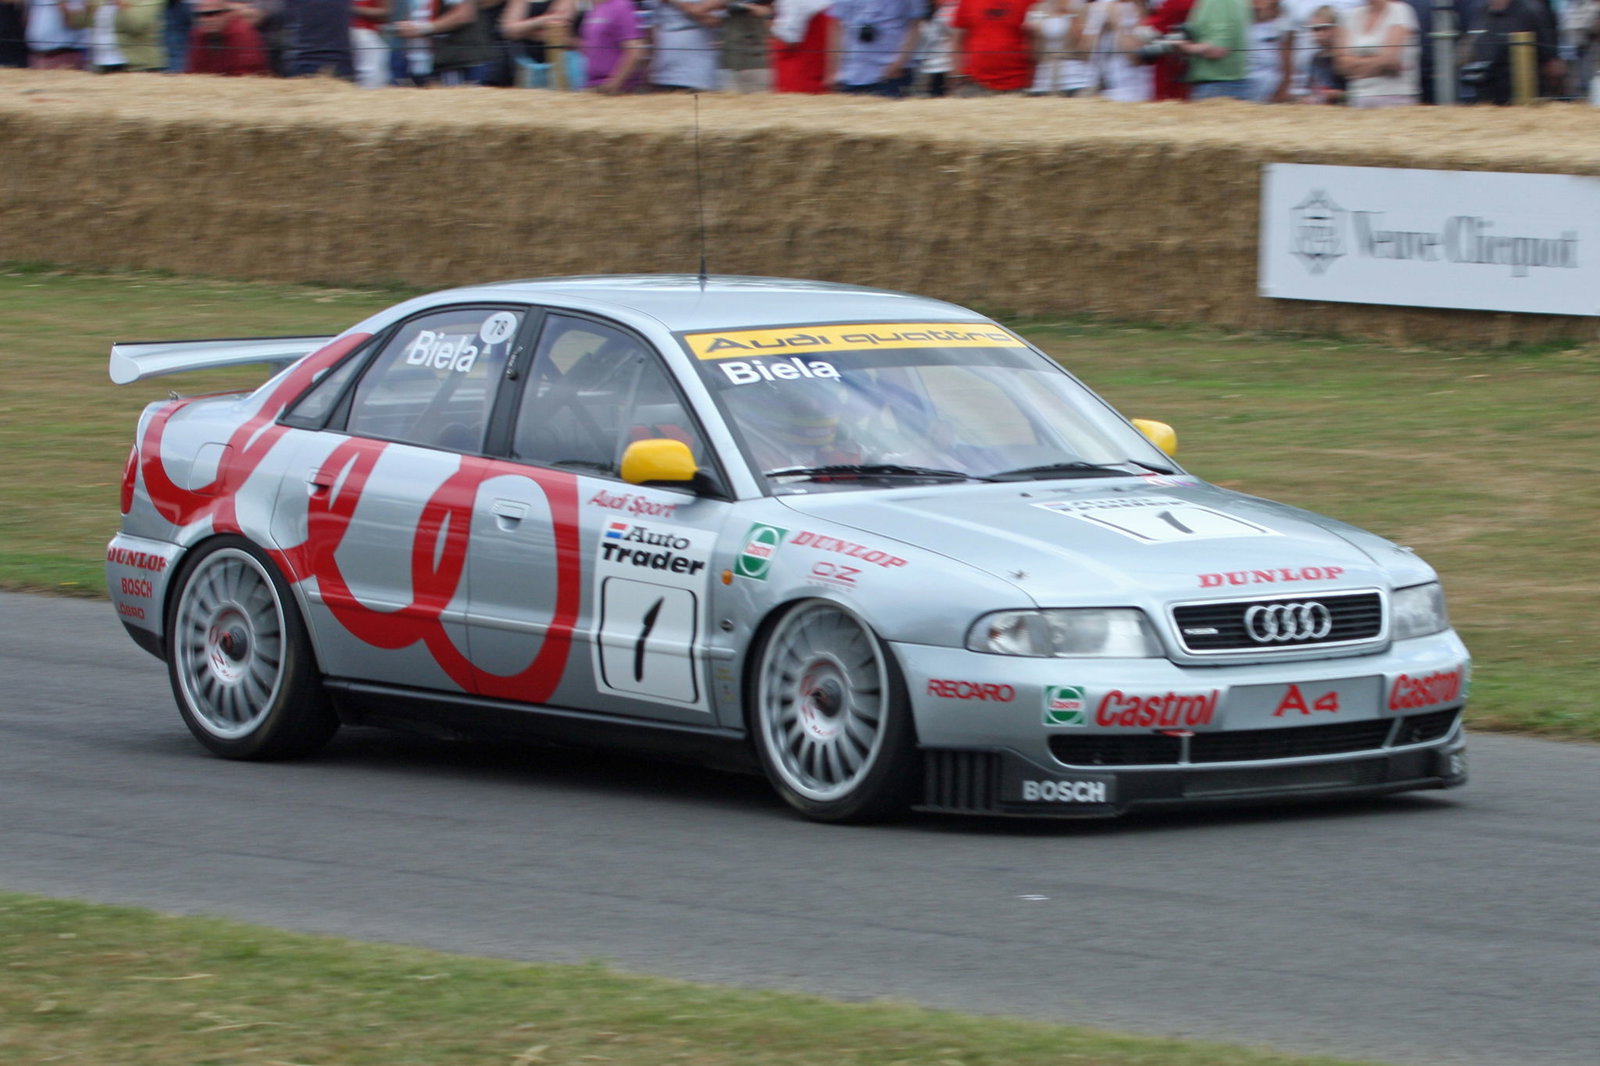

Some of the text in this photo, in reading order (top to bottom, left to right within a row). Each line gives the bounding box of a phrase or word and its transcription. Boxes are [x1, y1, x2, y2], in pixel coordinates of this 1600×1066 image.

[406, 330, 478, 372] Biela
[705, 329, 1015, 353] Audi quattro
[718, 357, 841, 386] Biela
[588, 490, 677, 518] Audi Sport
[622, 525, 690, 550] Auto
[789, 531, 909, 568] DUNLOP
[107, 548, 166, 572] DUNLOP
[601, 542, 705, 575] Trader
[121, 577, 152, 599] BOSCH
[1195, 565, 1345, 588] DUNLOP
[634, 596, 664, 682] 1
[927, 679, 1016, 702] RECARO
[1272, 683, 1339, 716] A4
[1095, 689, 1220, 728] Castrol
[1022, 780, 1106, 802] BOSCH
